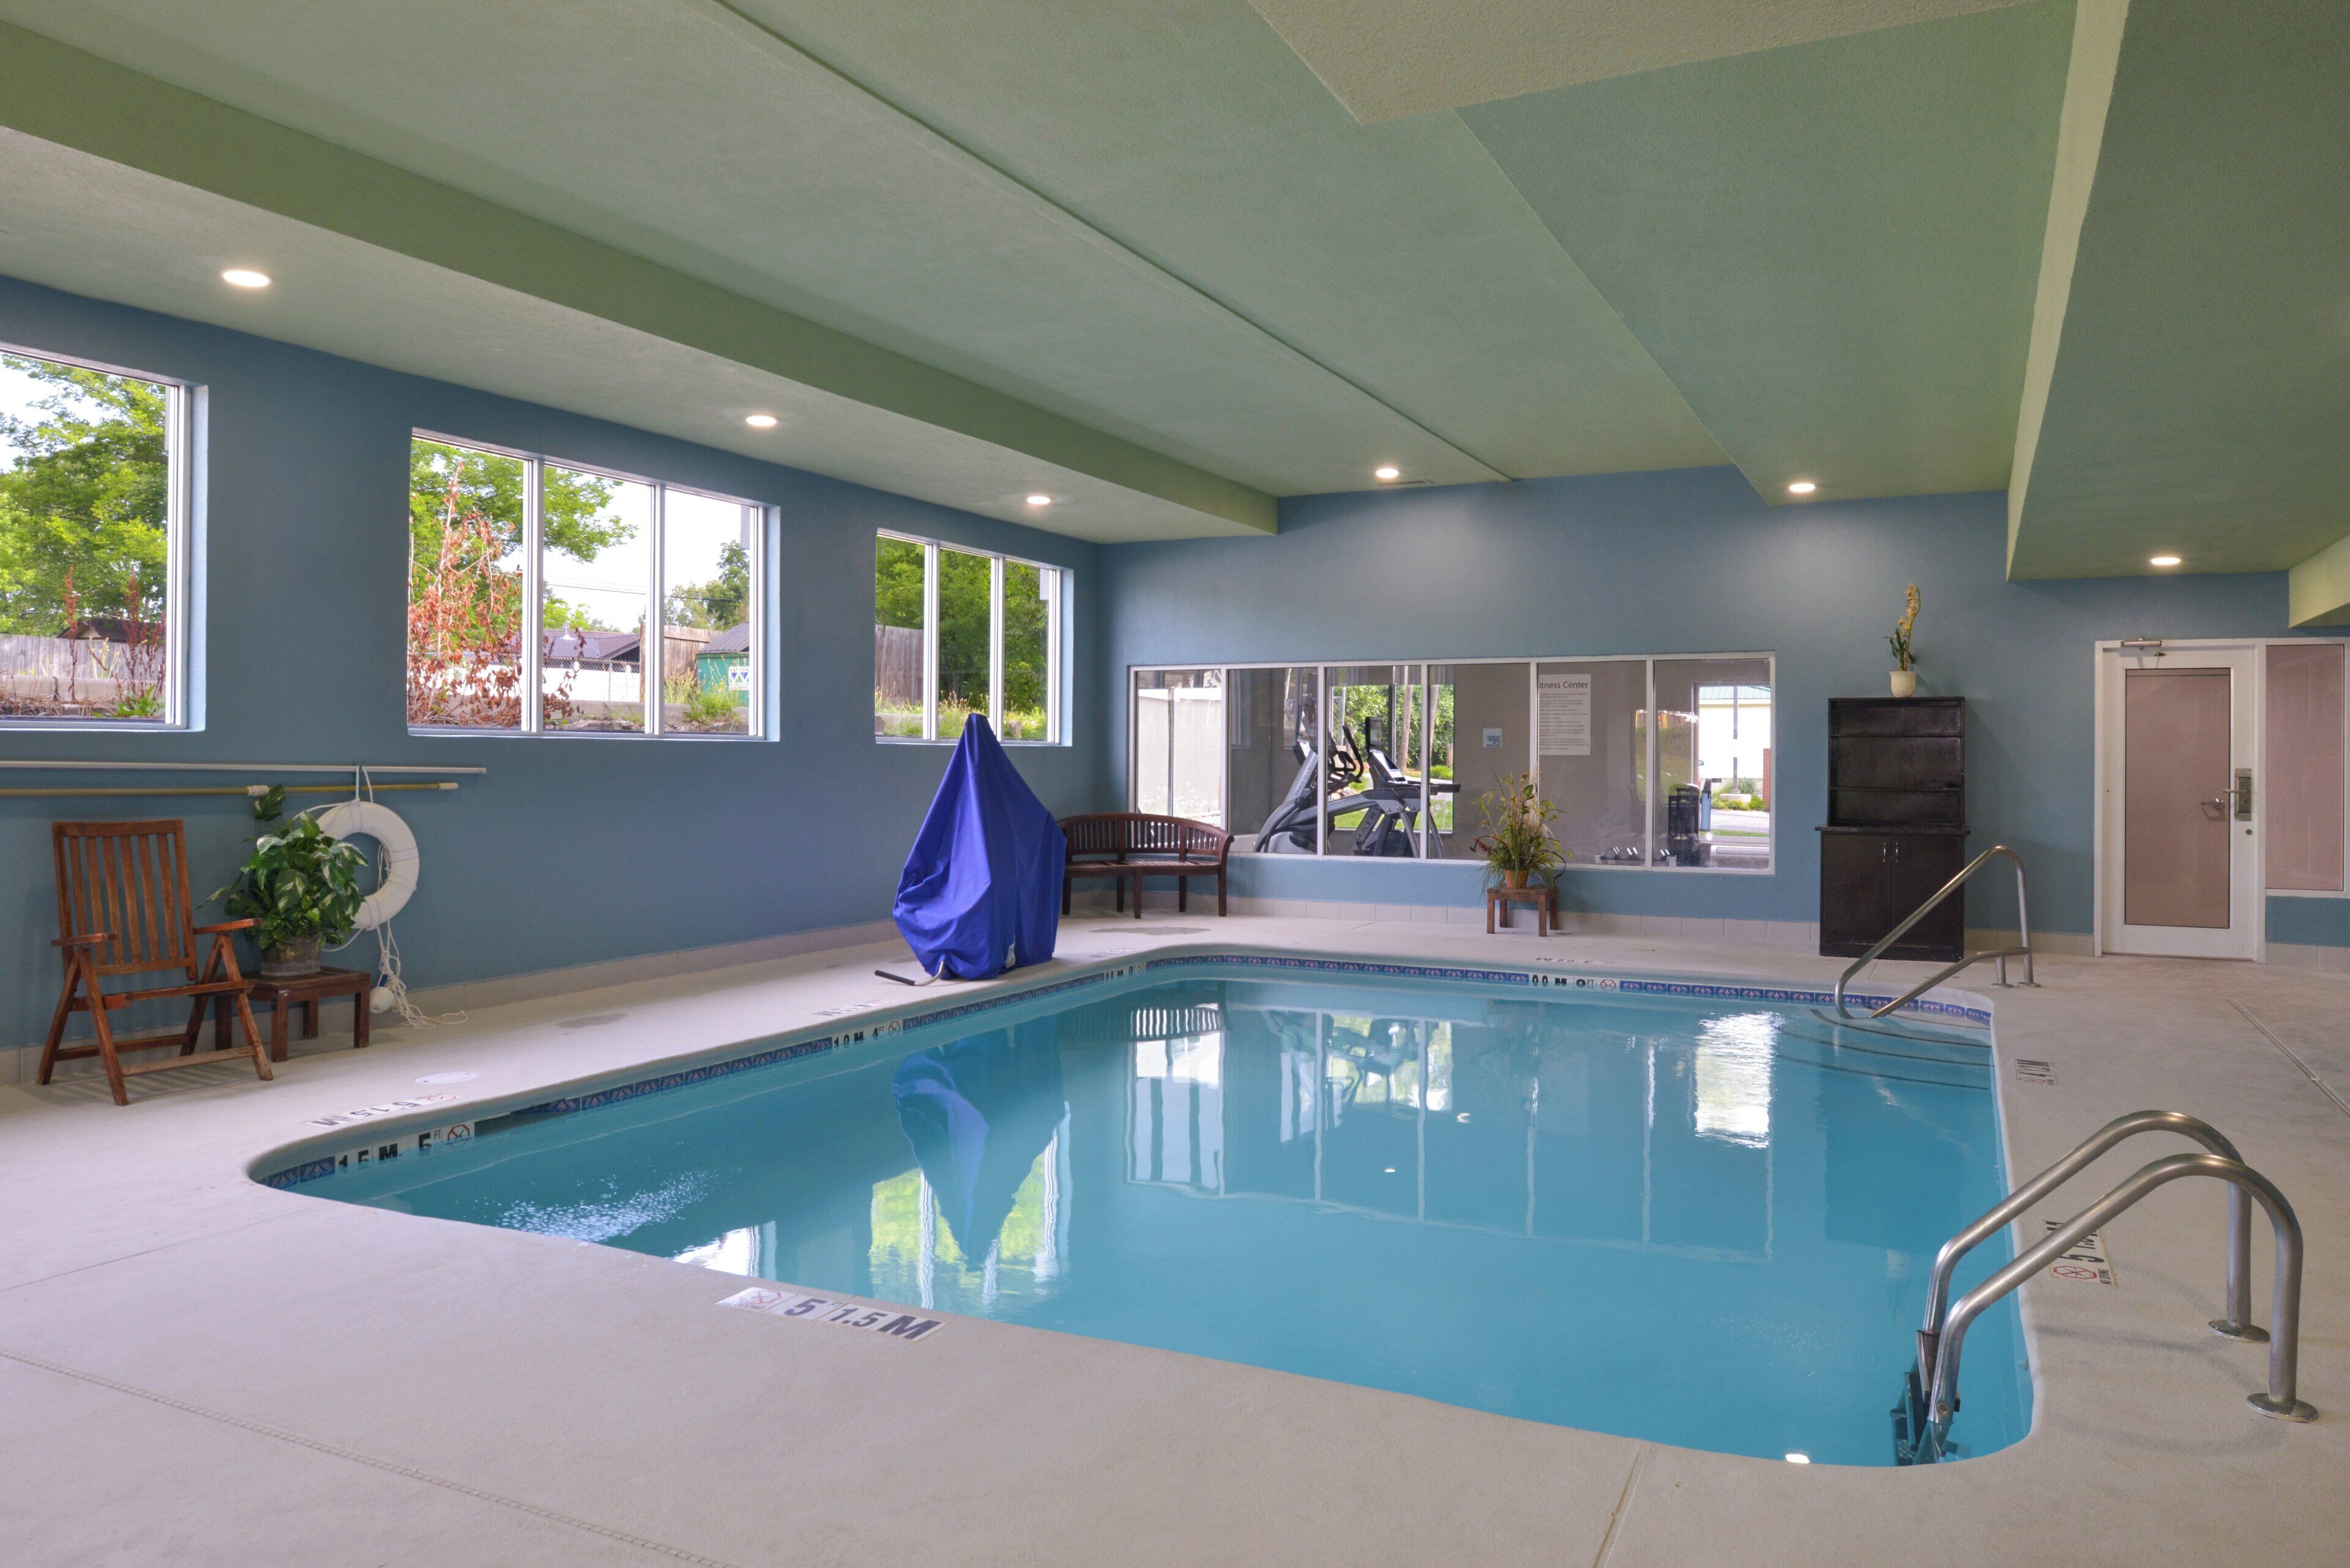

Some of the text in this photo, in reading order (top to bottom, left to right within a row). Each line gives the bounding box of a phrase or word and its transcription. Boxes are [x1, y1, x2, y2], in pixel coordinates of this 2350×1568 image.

[1356, 807, 1379, 842] MATRI
[311, 1115, 351, 1126] M
[379, 1143, 398, 1160] M
[434, 1129, 441, 1140] FT
[784, 1297, 828, 1316] 5
[829, 1308, 888, 1327] 1.5
[877, 1315, 942, 1340] M
